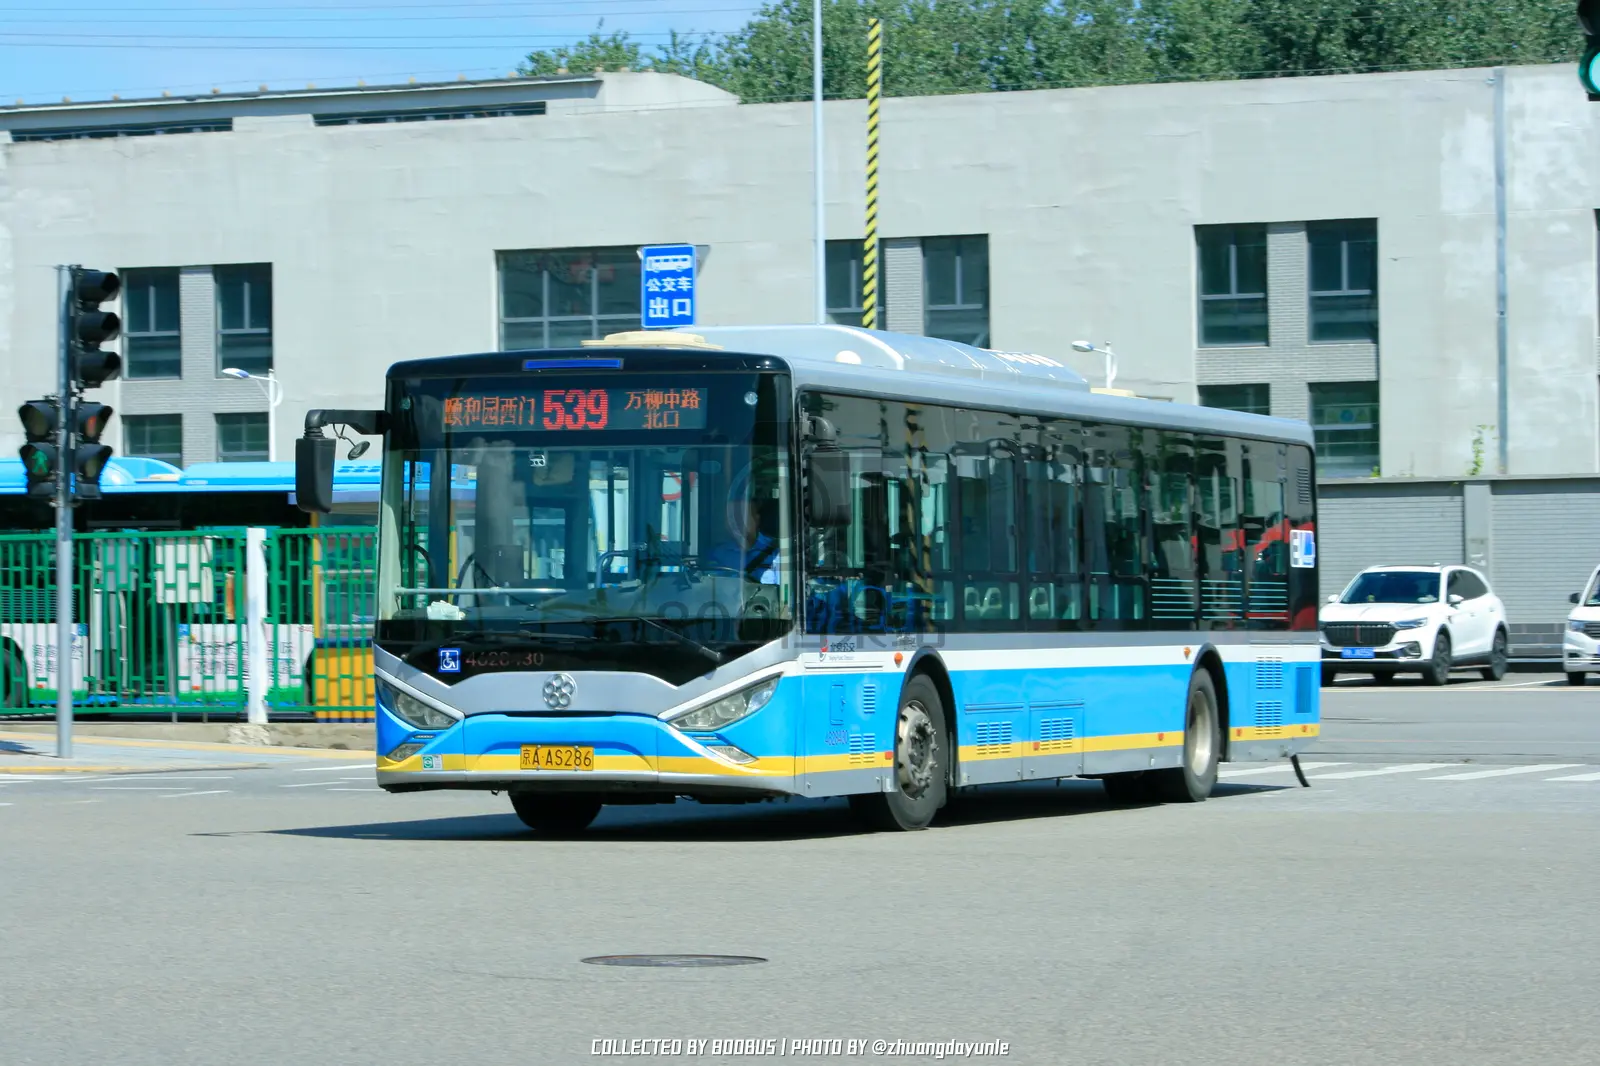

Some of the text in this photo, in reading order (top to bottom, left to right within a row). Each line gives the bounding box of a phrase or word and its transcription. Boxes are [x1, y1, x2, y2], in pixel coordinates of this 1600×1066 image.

[646, 277, 693, 292] 公交车
[648, 297, 692, 318] 出口
[543, 389, 608, 430] 539
[625, 388, 702, 410] 万柳中路
[444, 396, 535, 425] 颐和园西门
[643, 410, 680, 429] 北口
